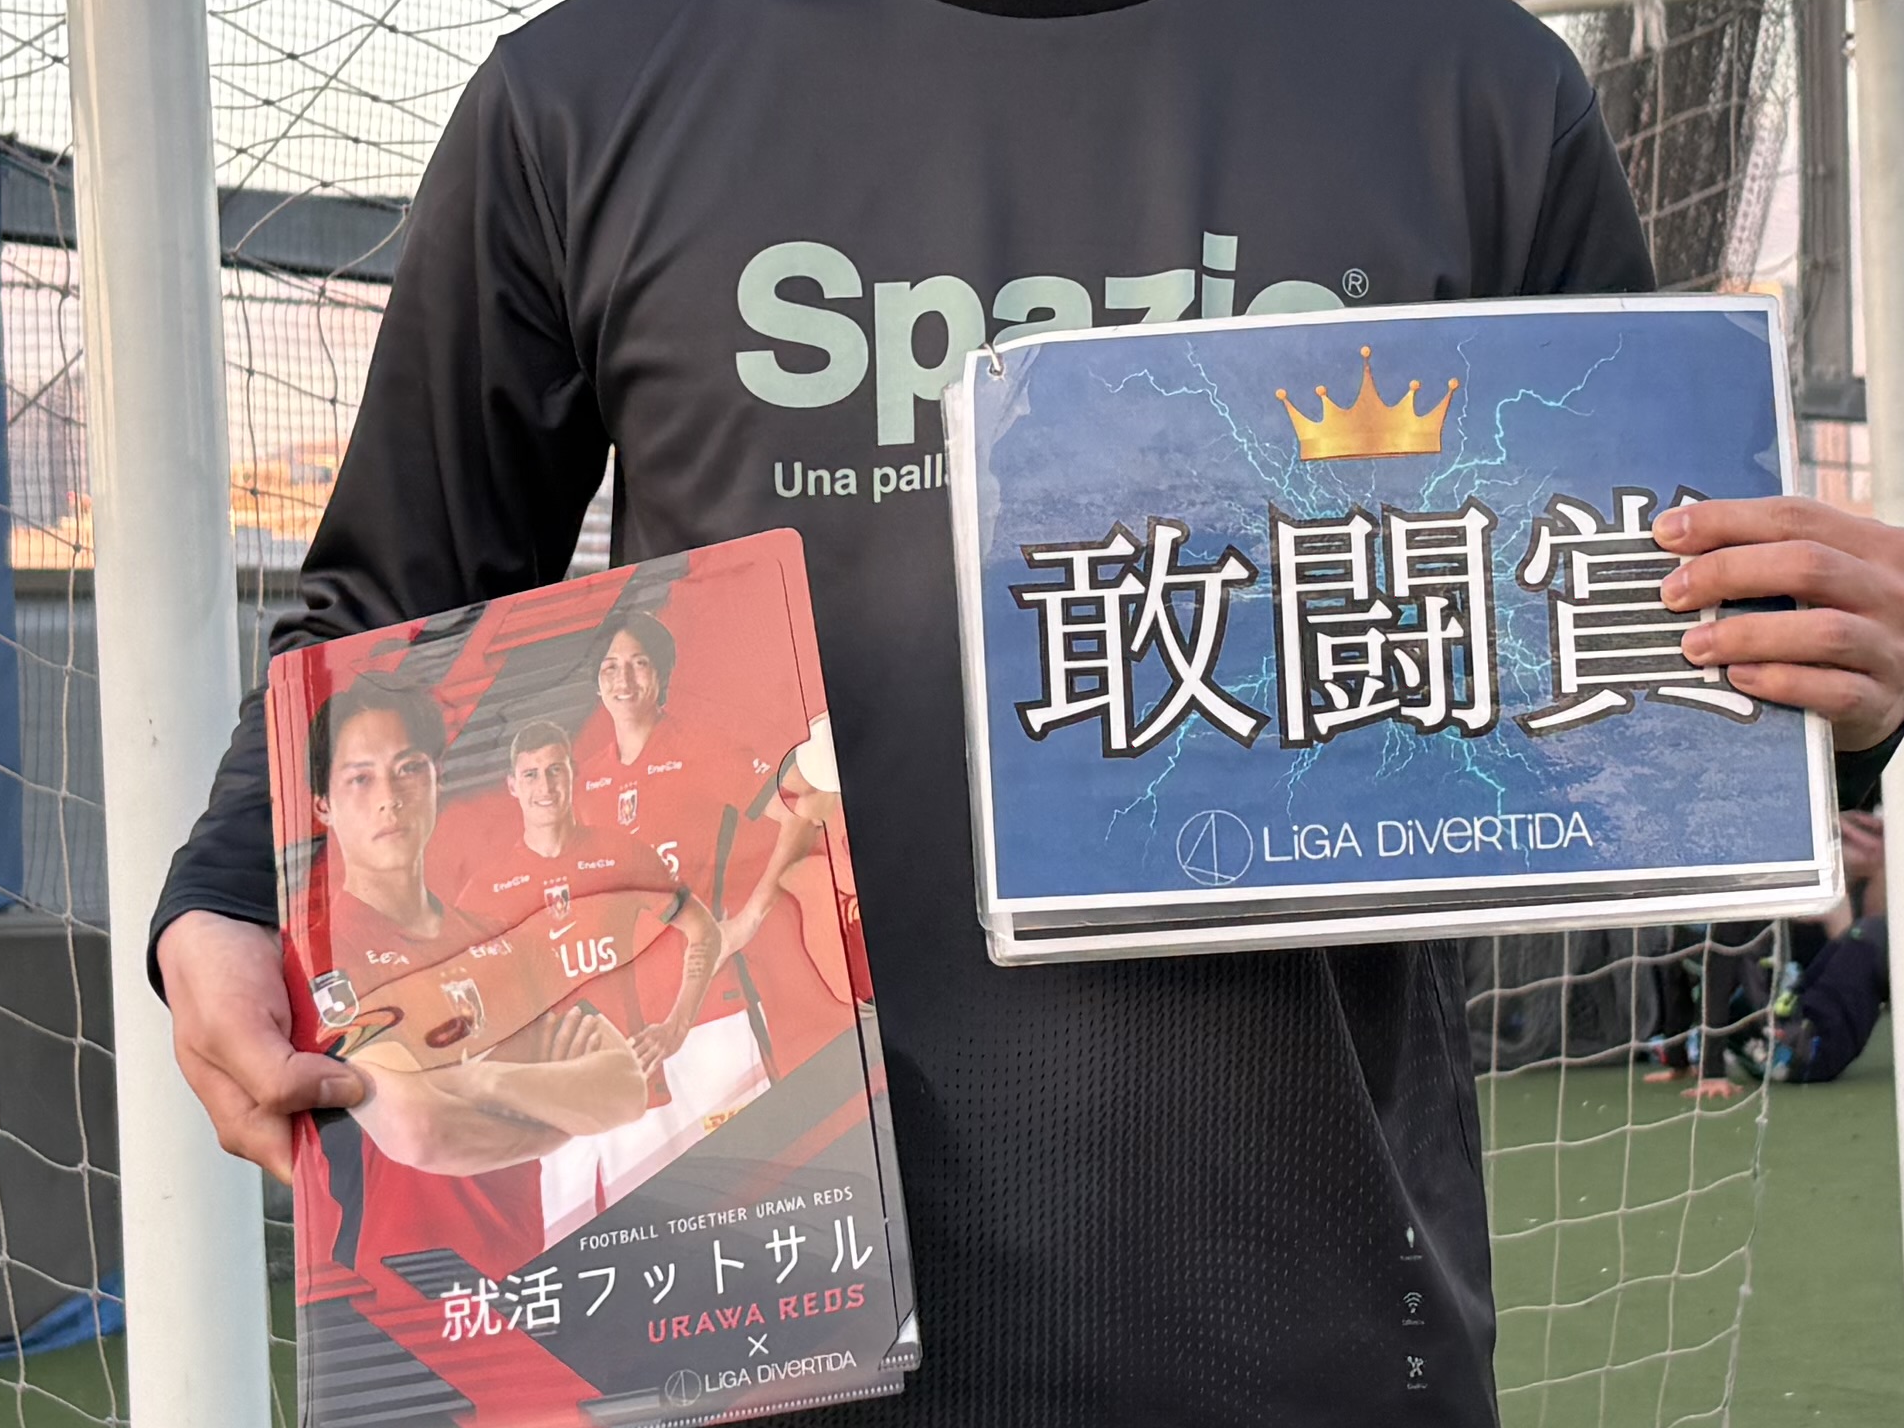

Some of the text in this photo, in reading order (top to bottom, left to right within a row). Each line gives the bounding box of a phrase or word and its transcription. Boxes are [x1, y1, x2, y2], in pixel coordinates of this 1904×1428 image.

[773, 452, 950, 503] Una pall
[1011, 486, 1760, 756] 敢闘賞
[553, 935, 618, 977] LUS
[579, 1185, 854, 1251] FOOTBALL TOGETHER URAWA REDS
[438, 1214, 874, 1342] 就活フットサル
[647, 1283, 866, 1344] URAWA REDS
